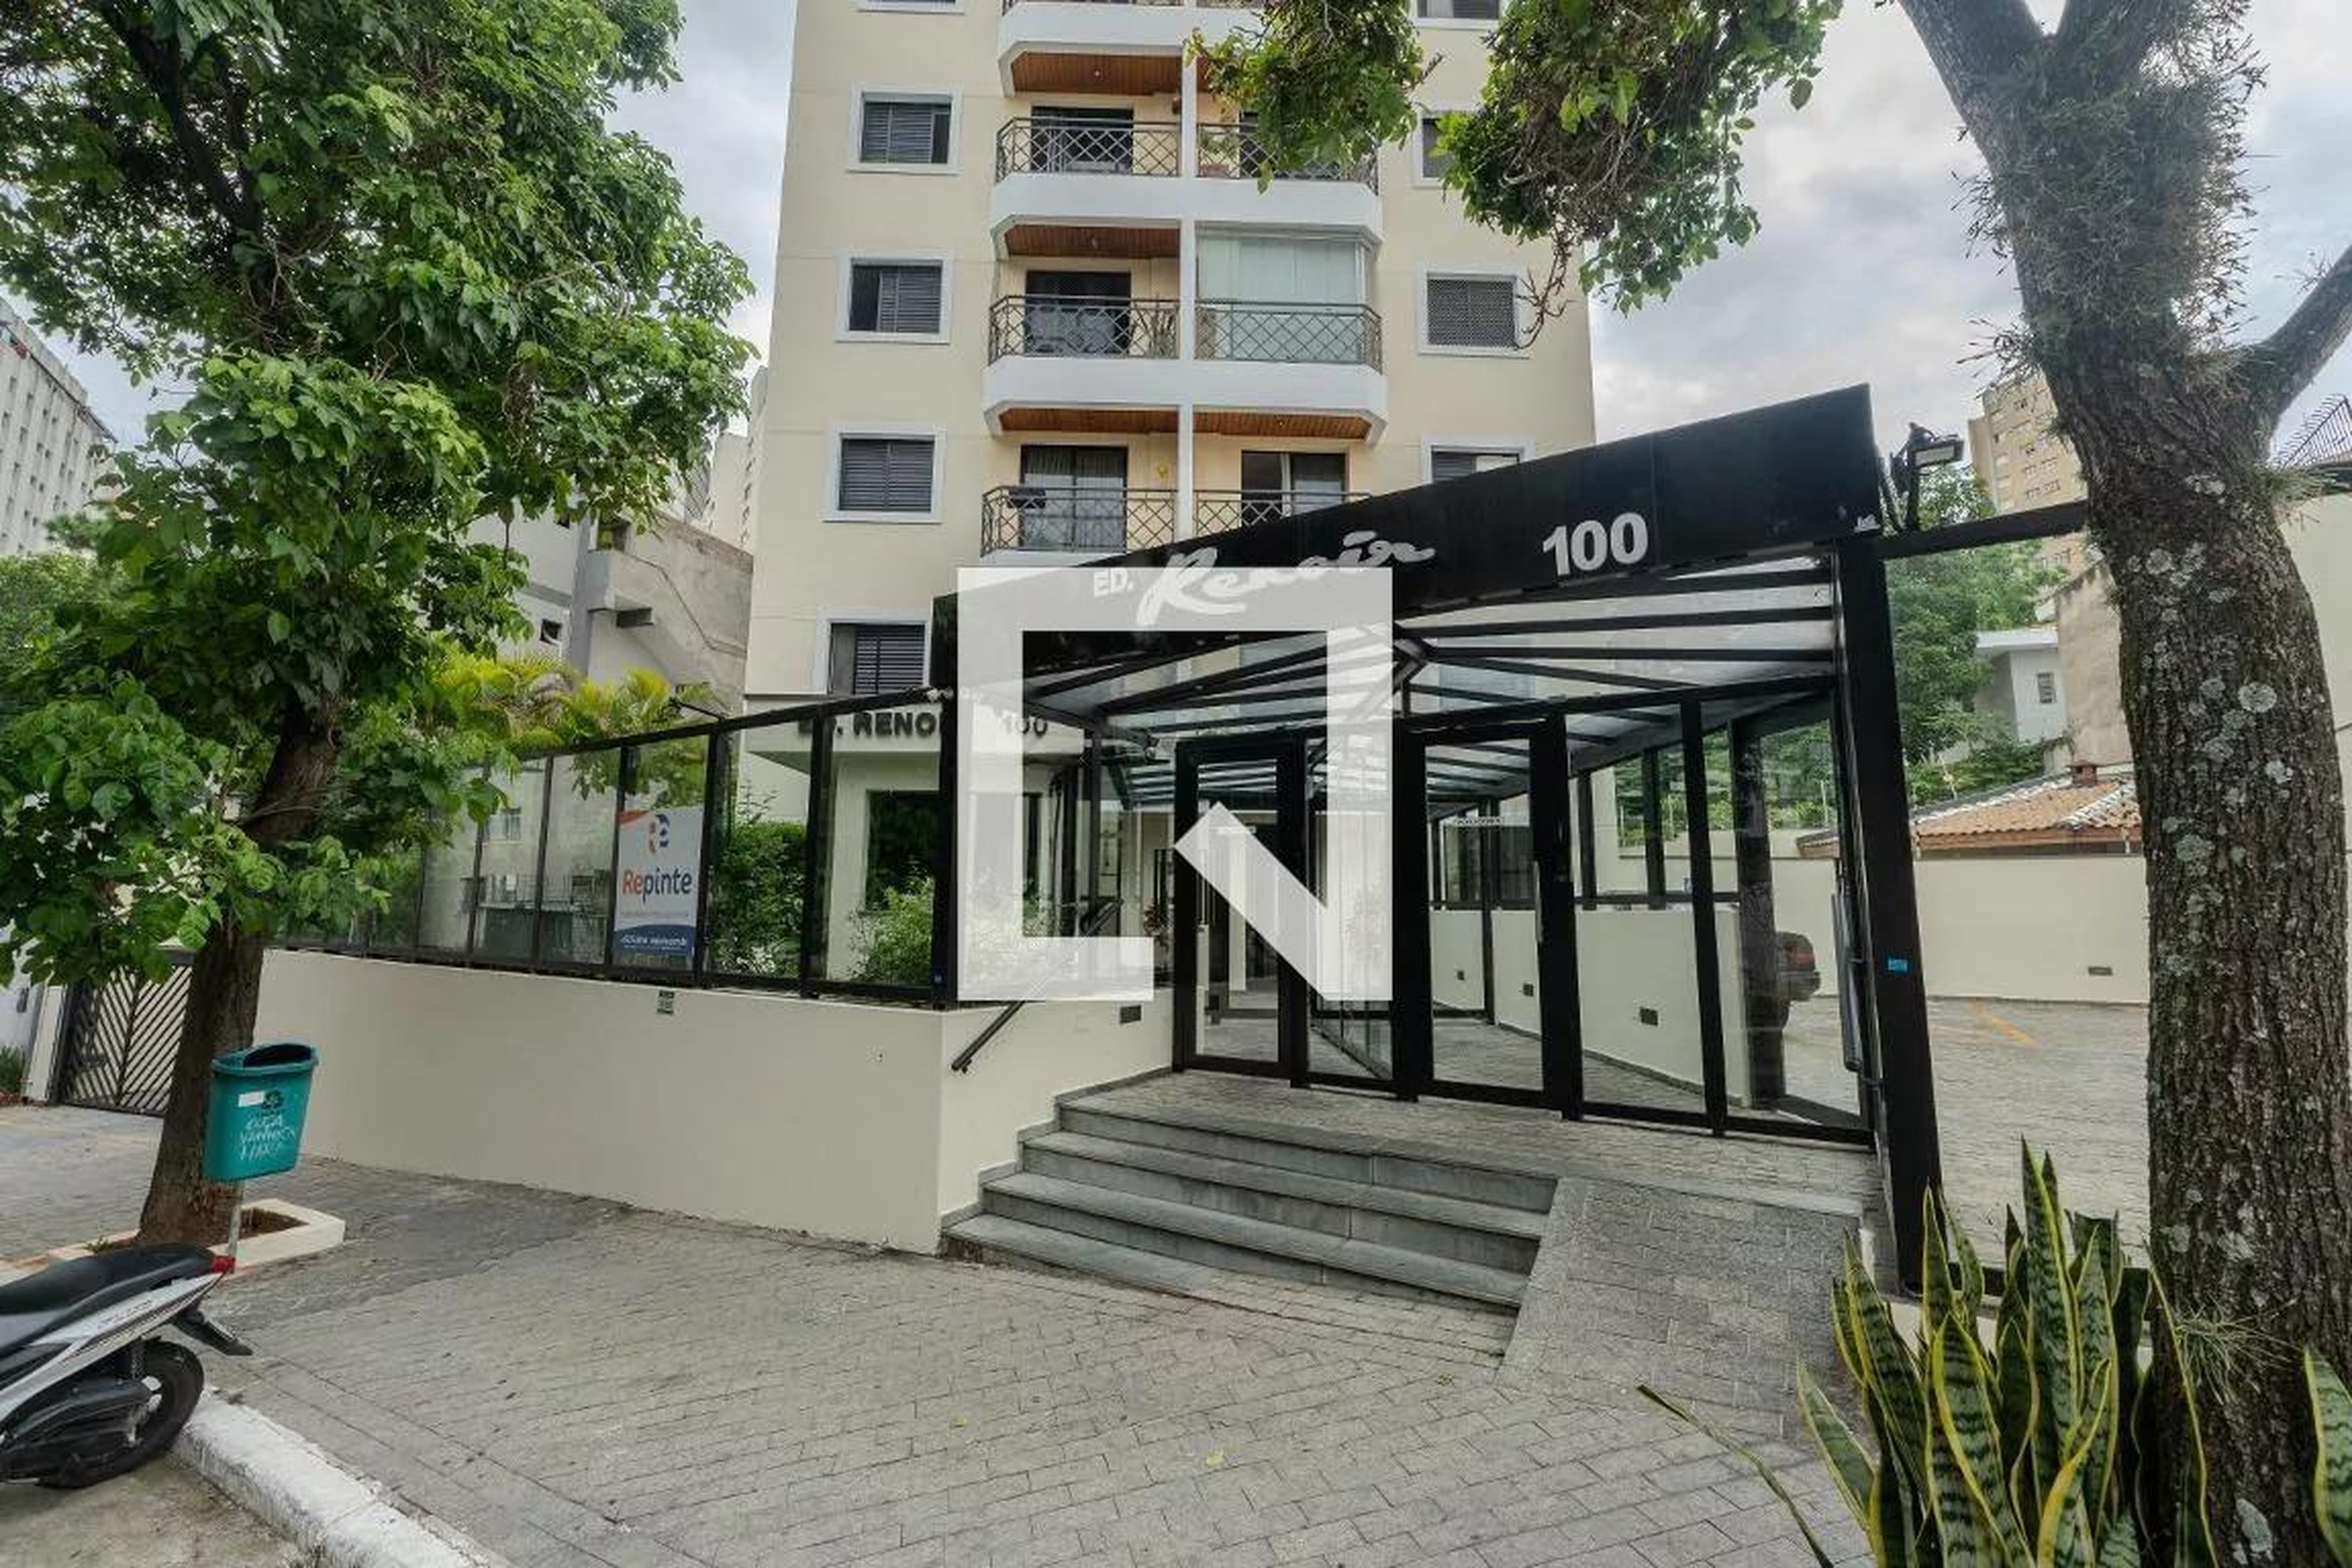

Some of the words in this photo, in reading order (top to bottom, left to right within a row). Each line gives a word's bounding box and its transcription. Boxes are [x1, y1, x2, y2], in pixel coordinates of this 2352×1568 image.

[1093, 567, 1134, 598] ED.
[1542, 511, 1648, 576] 100
[853, 712, 938, 737] RENO
[623, 867, 692, 903] Repinte
